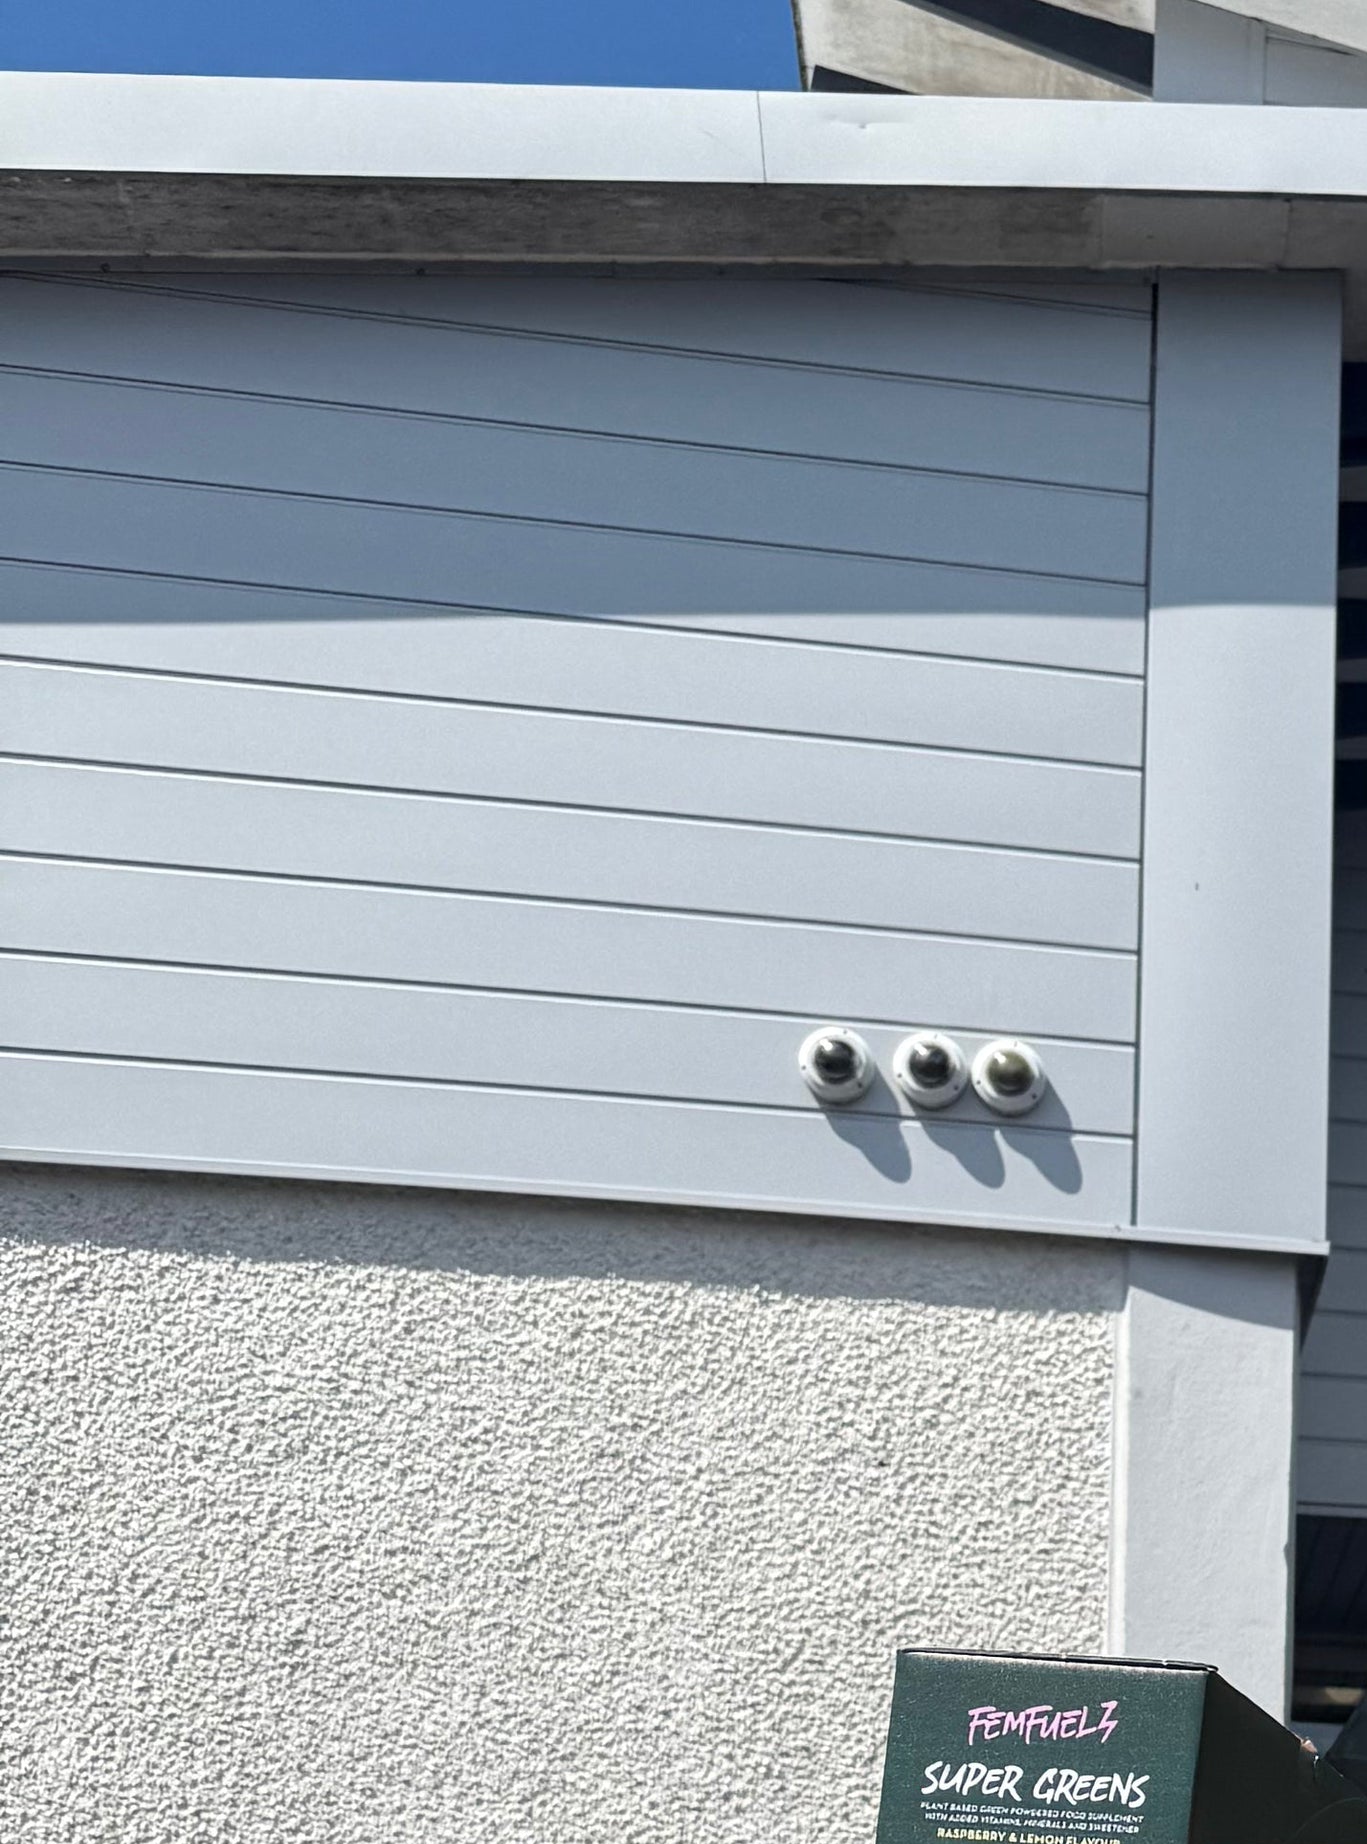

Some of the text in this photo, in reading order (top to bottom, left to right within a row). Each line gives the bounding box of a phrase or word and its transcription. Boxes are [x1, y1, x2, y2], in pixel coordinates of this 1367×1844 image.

[921, 1761, 1150, 1808] SUPER GREENS
[937, 1827, 1006, 1842] RASPBERRY
[1008, 1832, 1018, 1842] &
